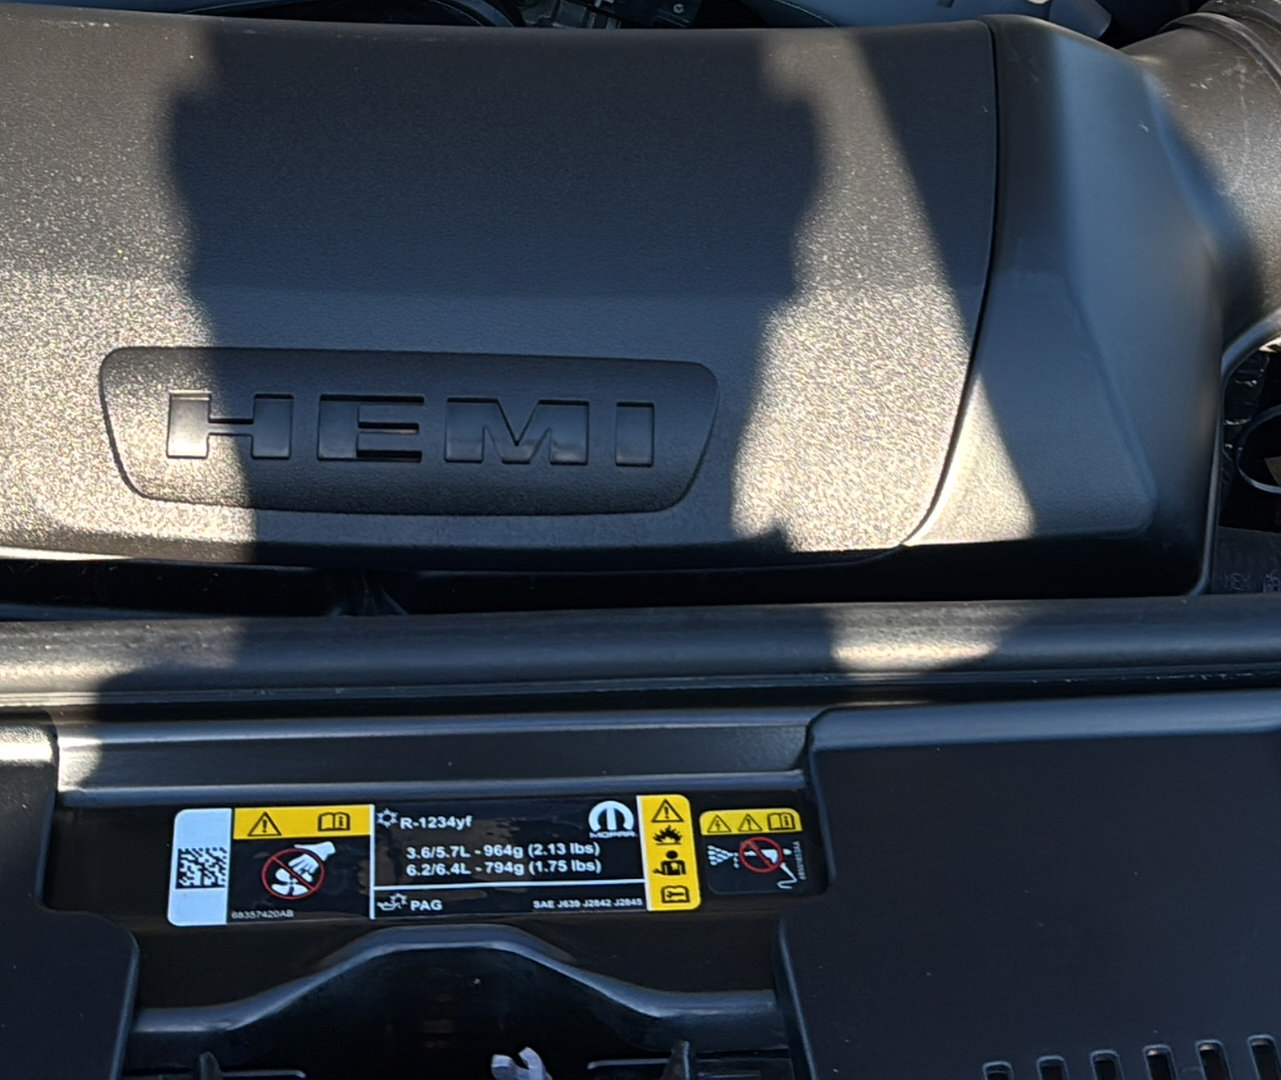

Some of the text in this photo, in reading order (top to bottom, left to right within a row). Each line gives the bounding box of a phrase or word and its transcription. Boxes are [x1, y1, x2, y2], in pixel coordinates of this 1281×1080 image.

[164, 392, 657, 468] HEMI
[400, 815, 473, 831] R-1234yf
[406, 845, 471, 859] 3.6/5.7L
[483, 843, 524, 859] 964g
[527, 842, 568, 858] (2.13
[570, 841, 601, 857] lbs)
[406, 862, 472, 877] 6.2/6.4L
[484, 860, 525, 877] 794g
[528, 859, 569, 875] (1.75
[570, 858, 602, 874] lbs)
[410, 900, 443, 911] PAG
[532, 900, 555, 909] SAE
[557, 899, 581, 908] J639
